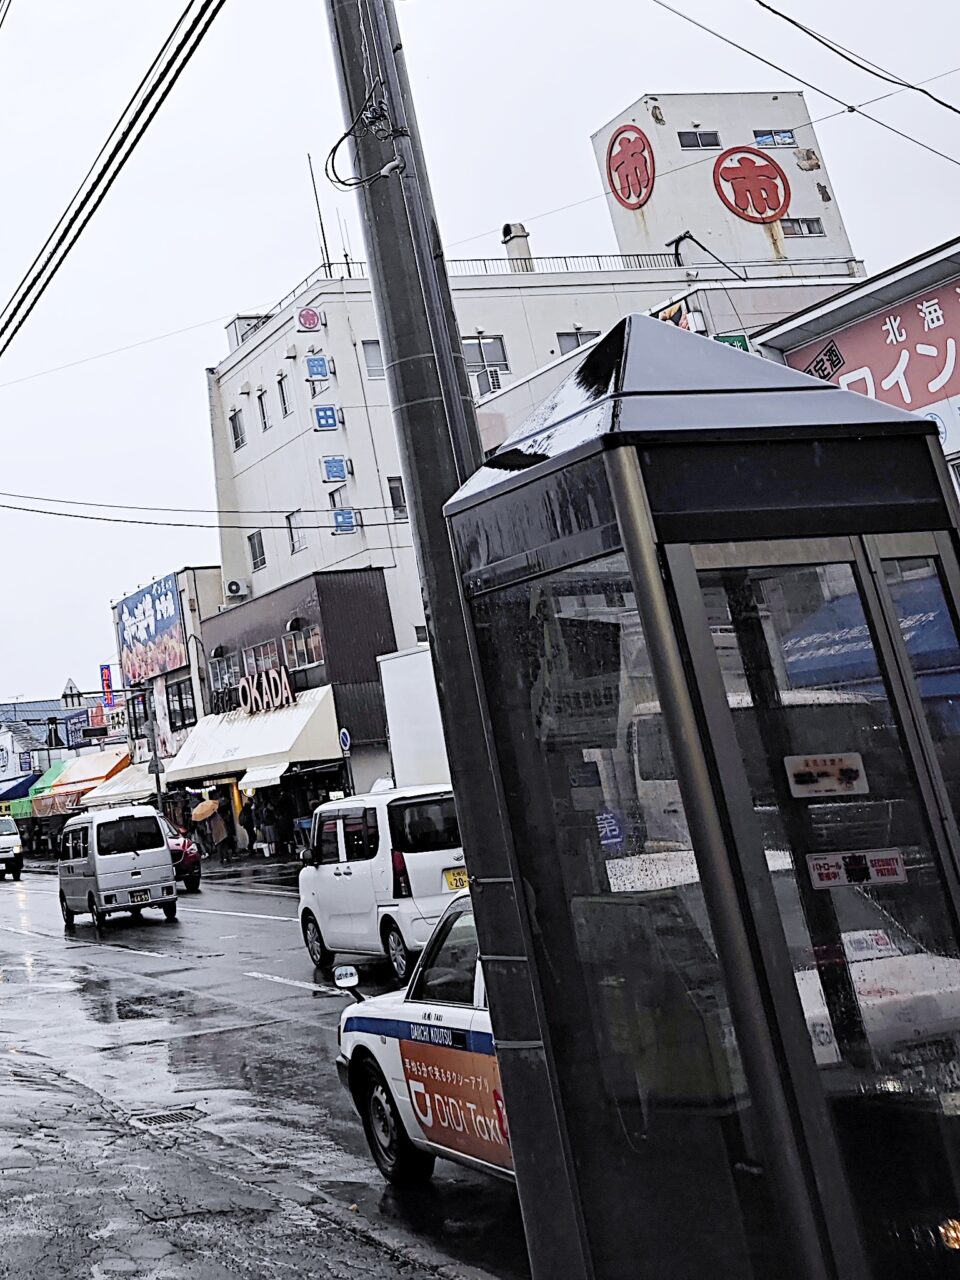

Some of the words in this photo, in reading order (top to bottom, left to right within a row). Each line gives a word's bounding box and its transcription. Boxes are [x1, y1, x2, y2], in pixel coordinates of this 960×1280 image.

[609, 136, 651, 200] 市
[720, 156, 781, 215] 市
[882, 286, 960, 345] 北海
[838, 337, 956, 404] ワイン
[239, 665, 294, 714] OKADA
[875, 868, 899, 877] PATROL
[404, 1057, 490, 1094] 平均5分で来るタクシーアプリ
[433, 1093, 470, 1135] DiDi
[465, 1101, 504, 1145] Taxi
